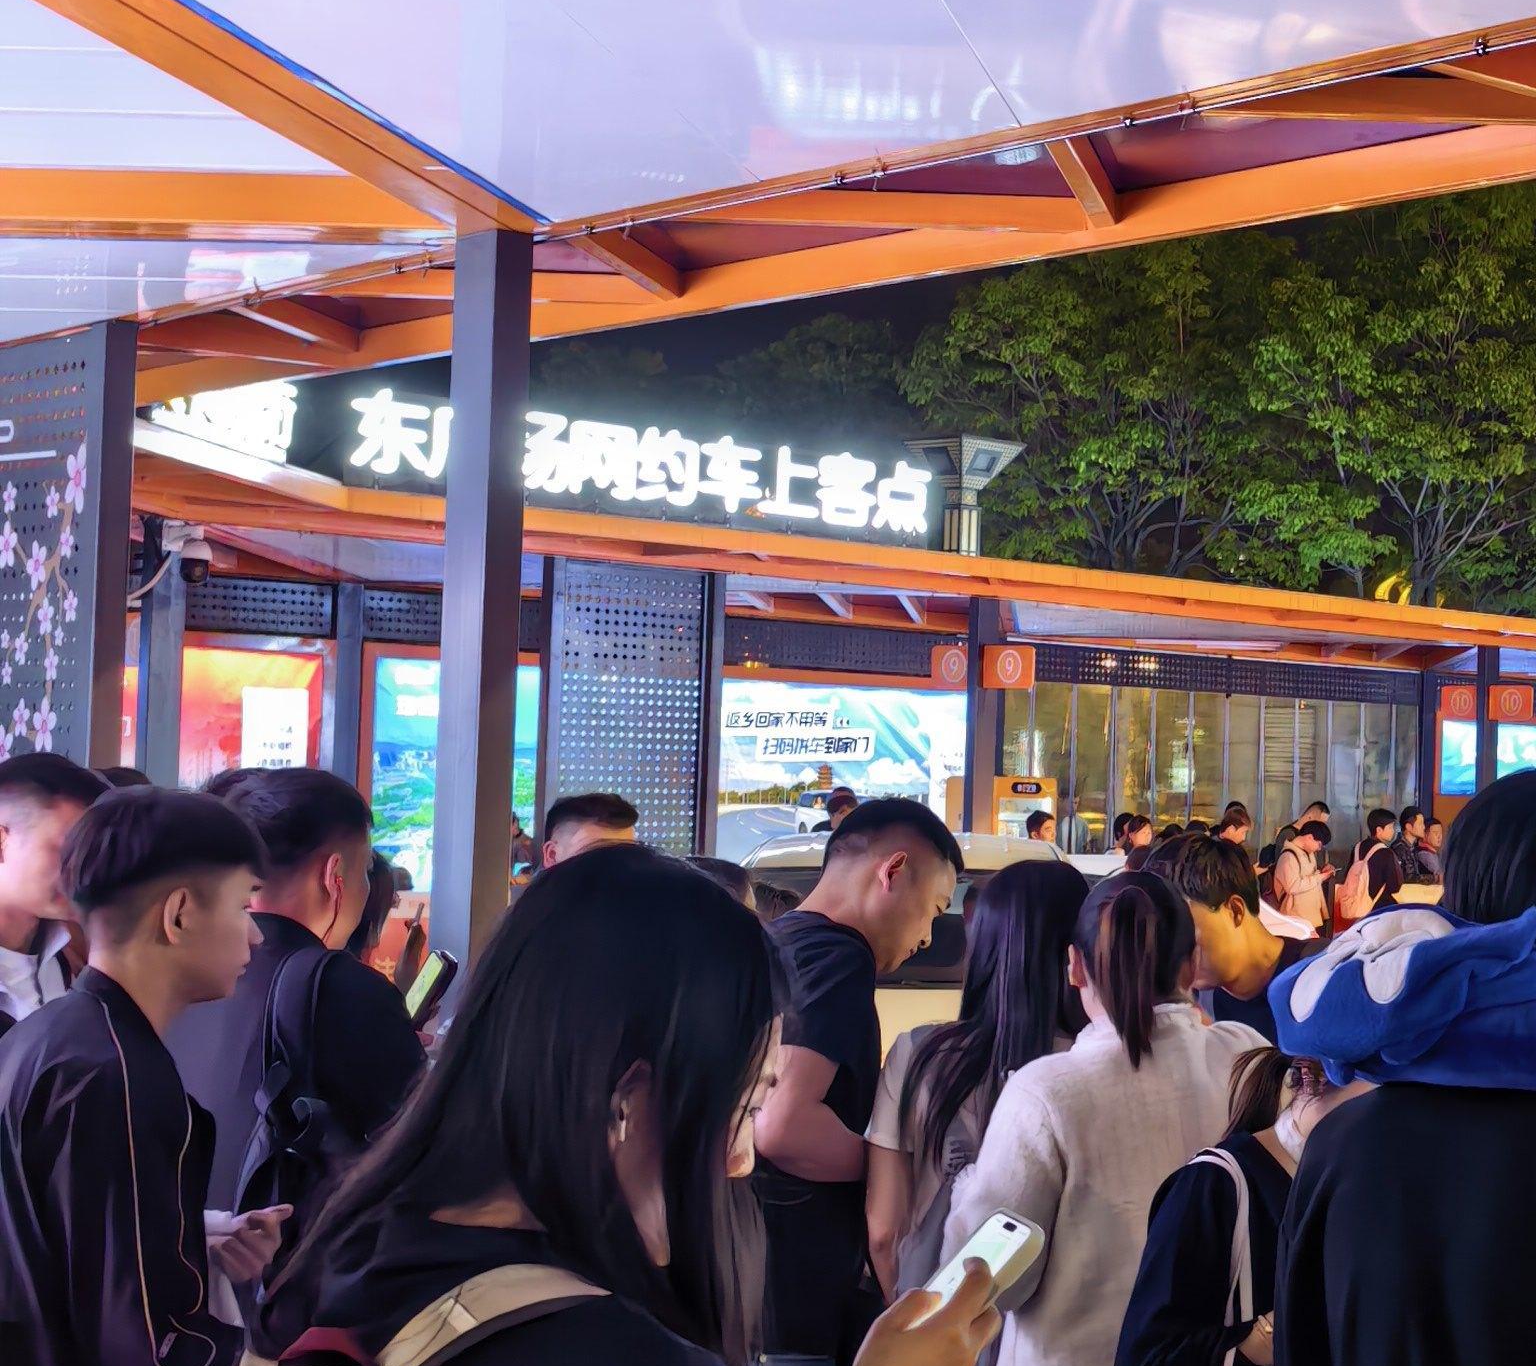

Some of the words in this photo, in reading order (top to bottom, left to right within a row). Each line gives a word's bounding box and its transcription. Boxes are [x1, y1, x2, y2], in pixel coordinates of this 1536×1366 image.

[351, 388, 932, 534] 东场网约车上客点
[725, 711, 828, 728] 返乡回家不用等
